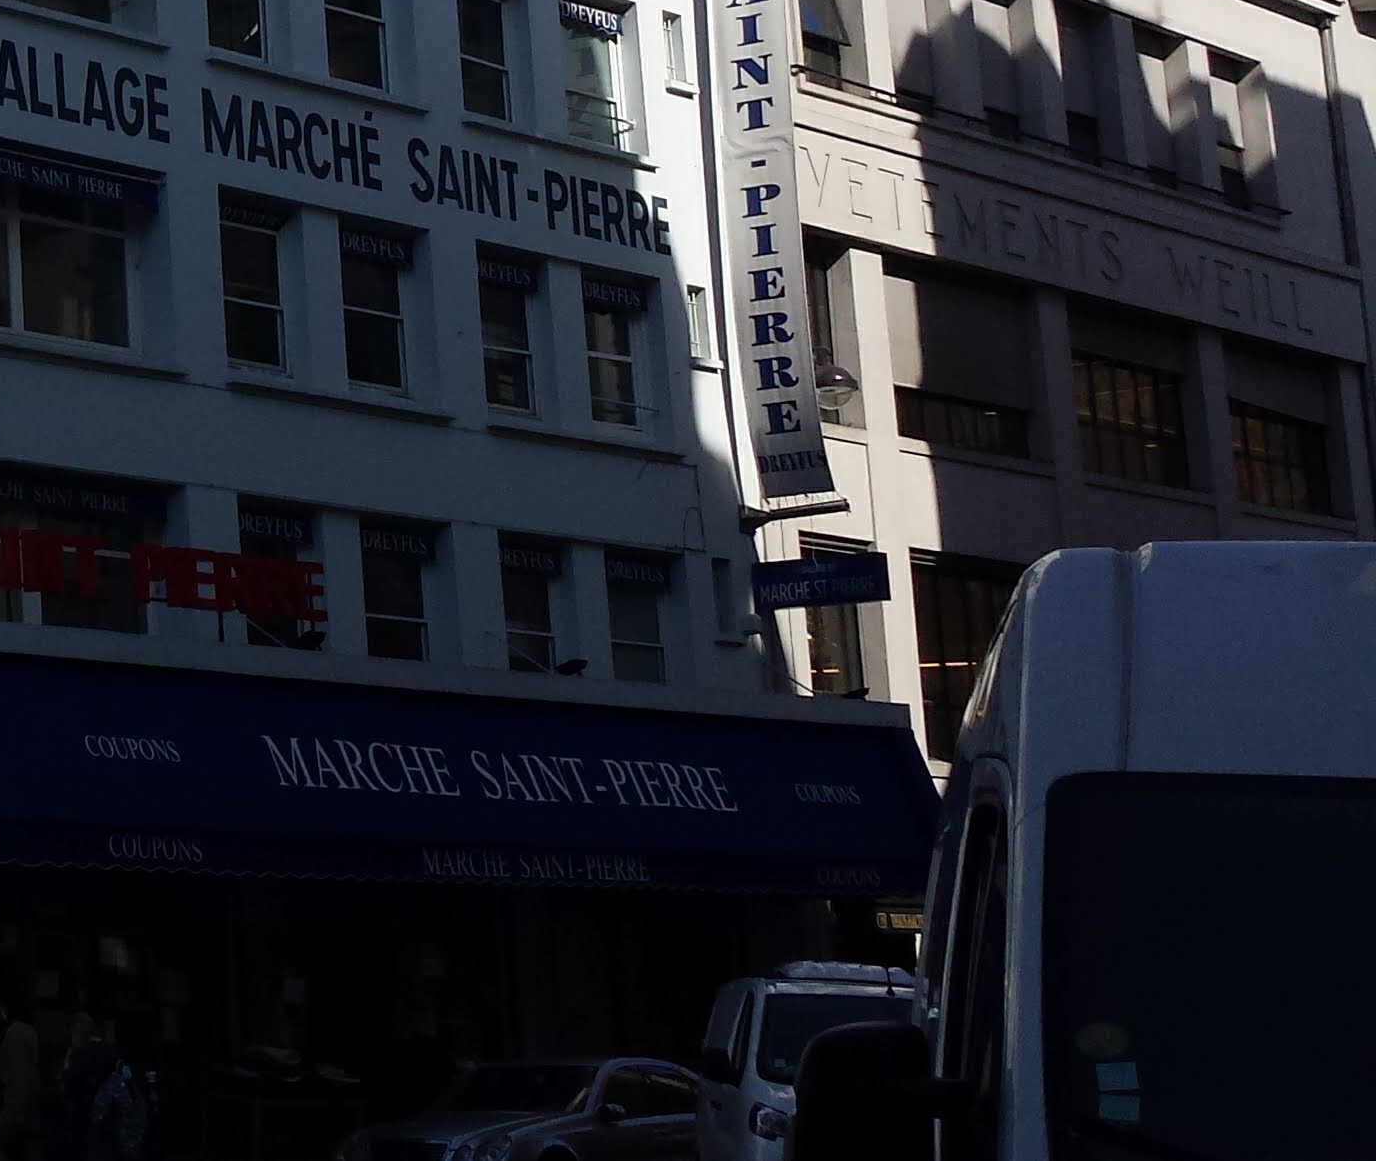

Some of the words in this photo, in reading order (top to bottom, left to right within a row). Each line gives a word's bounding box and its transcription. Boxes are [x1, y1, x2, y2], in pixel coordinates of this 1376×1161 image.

[561, 0, 618, 32] DREYFUS
[31, 166, 71, 190] SAINT
[78, 175, 123, 200] PIERRE
[202, 88, 383, 190] MARCHÉ
[408, 138, 672, 255] SAINT-PIERRE
[342, 232, 405, 259] DREYFUS
[583, 280, 641, 311] DREYFUS
[1165, 246, 1313, 336] WEILL
[239, 512, 303, 540] DREYFUS
[362, 527, 426, 555] DREYFUS
[131, 543, 328, 621] PIERRE
[759, 580, 811, 602] MARCHE
[83, 735, 181, 762] COUPONS
[259, 734, 461, 797] MARCHE
[470, 750, 739, 812] SAINT-PIERRE
[794, 783, 861, 806] COUPONS
[108, 833, 205, 863] COUPONS
[422, 847, 510, 878] MARCHE
[519, 852, 650, 883] SAINT-PIERRE
